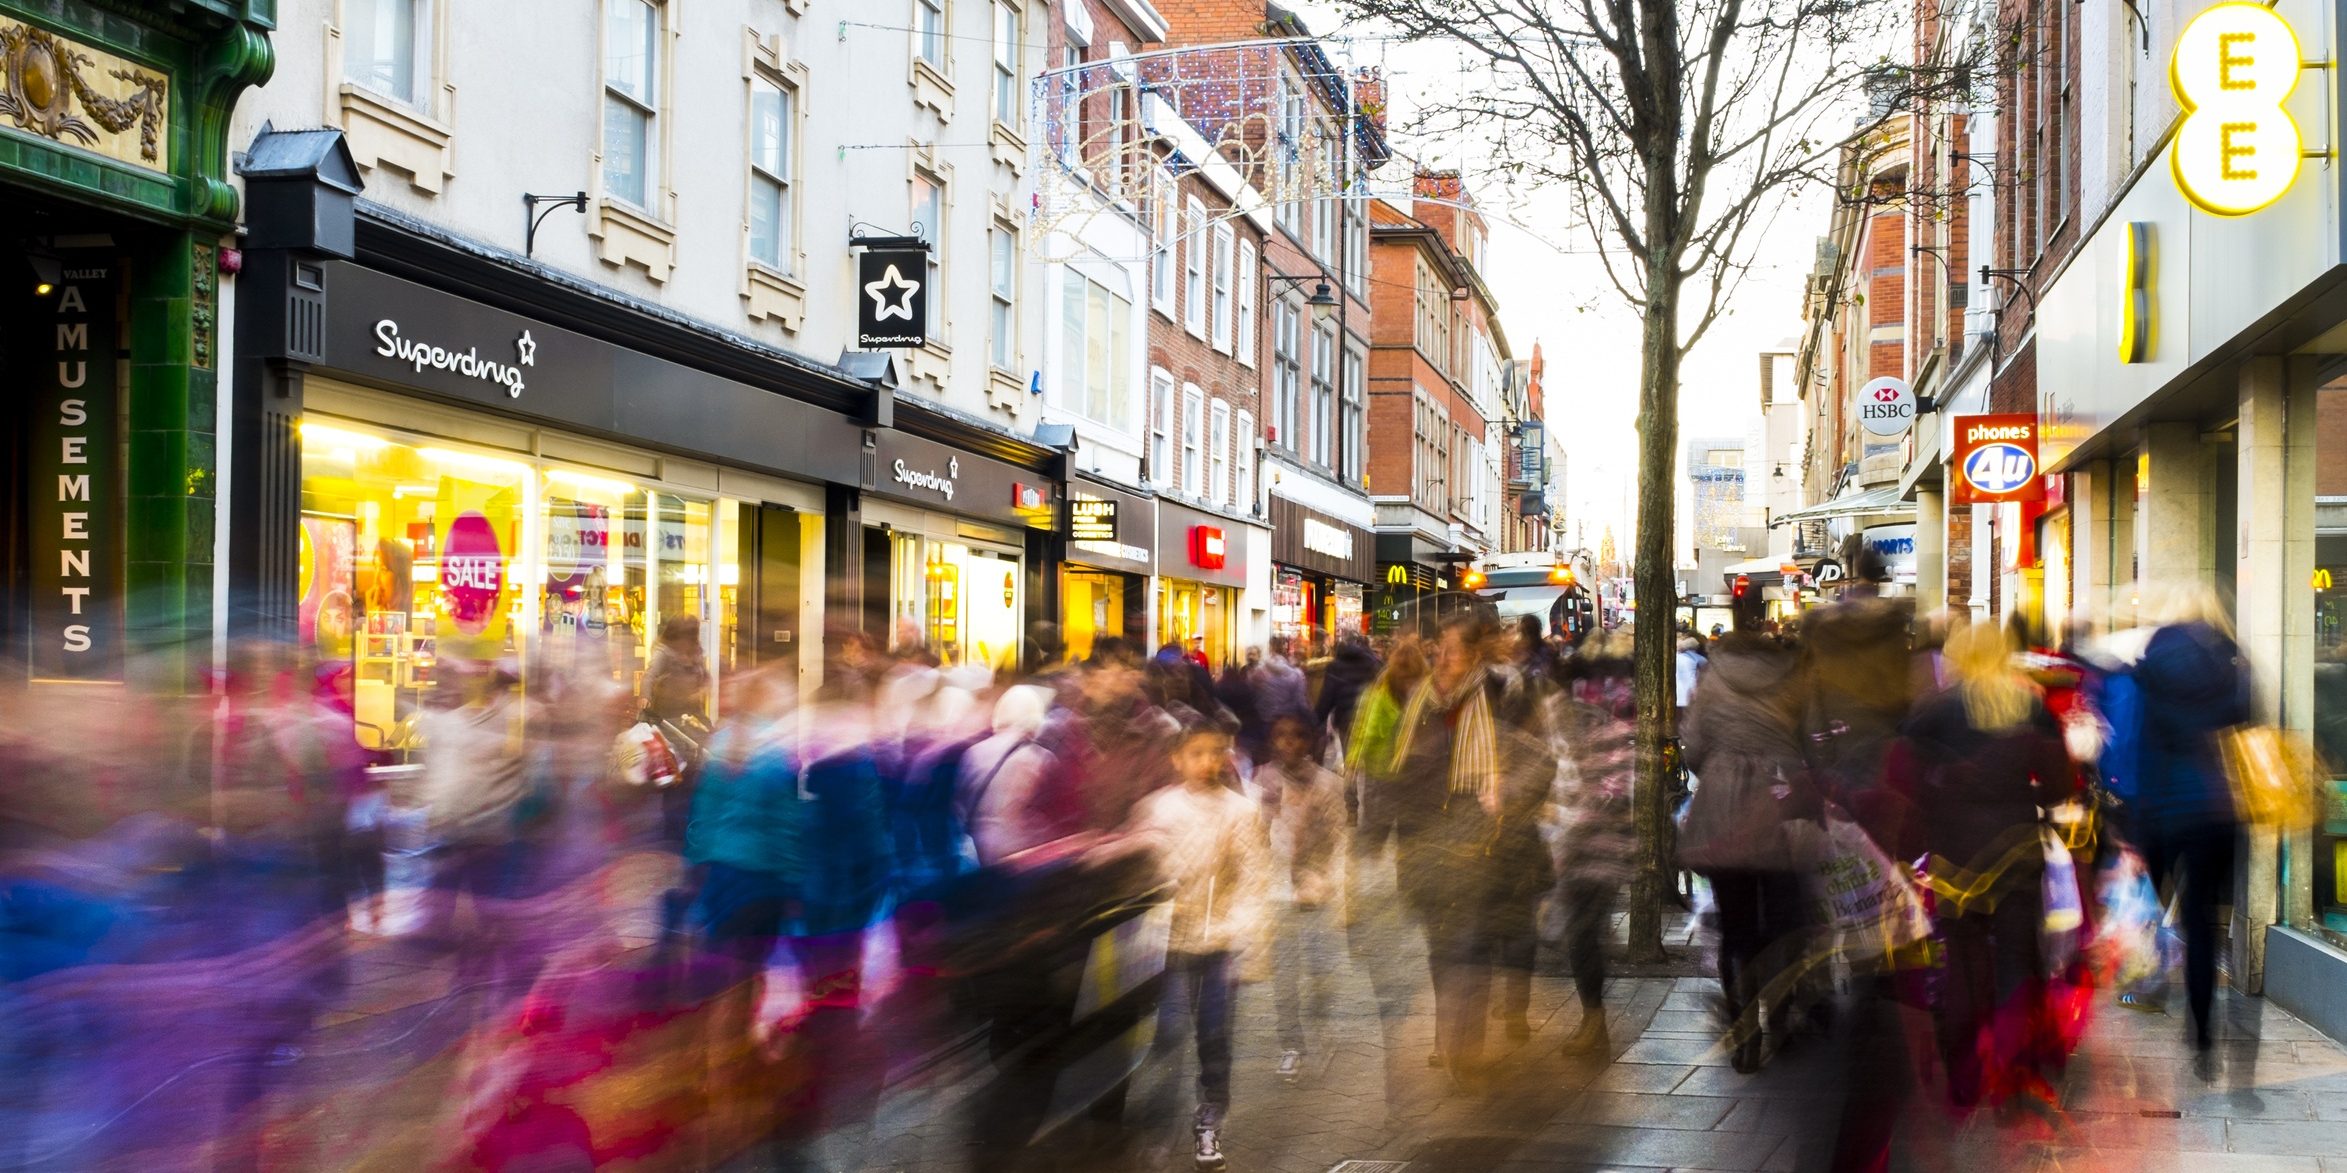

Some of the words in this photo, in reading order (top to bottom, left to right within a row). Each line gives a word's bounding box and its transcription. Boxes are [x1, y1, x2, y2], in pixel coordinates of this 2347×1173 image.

[63, 268, 108, 280] VALLEY
[860, 334, 923, 345] Superdrug
[376, 319, 525, 399] Superdrug
[1862, 403, 1912, 419] HSBC
[1968, 424, 2030, 444] phones
[57, 286, 92, 652] AMUSEMENTS
[894, 459, 954, 501] Superdrug
[1971, 446, 2028, 491] 4u
[447, 555, 497, 591] SALE
[1816, 564, 1841, 583] JD
